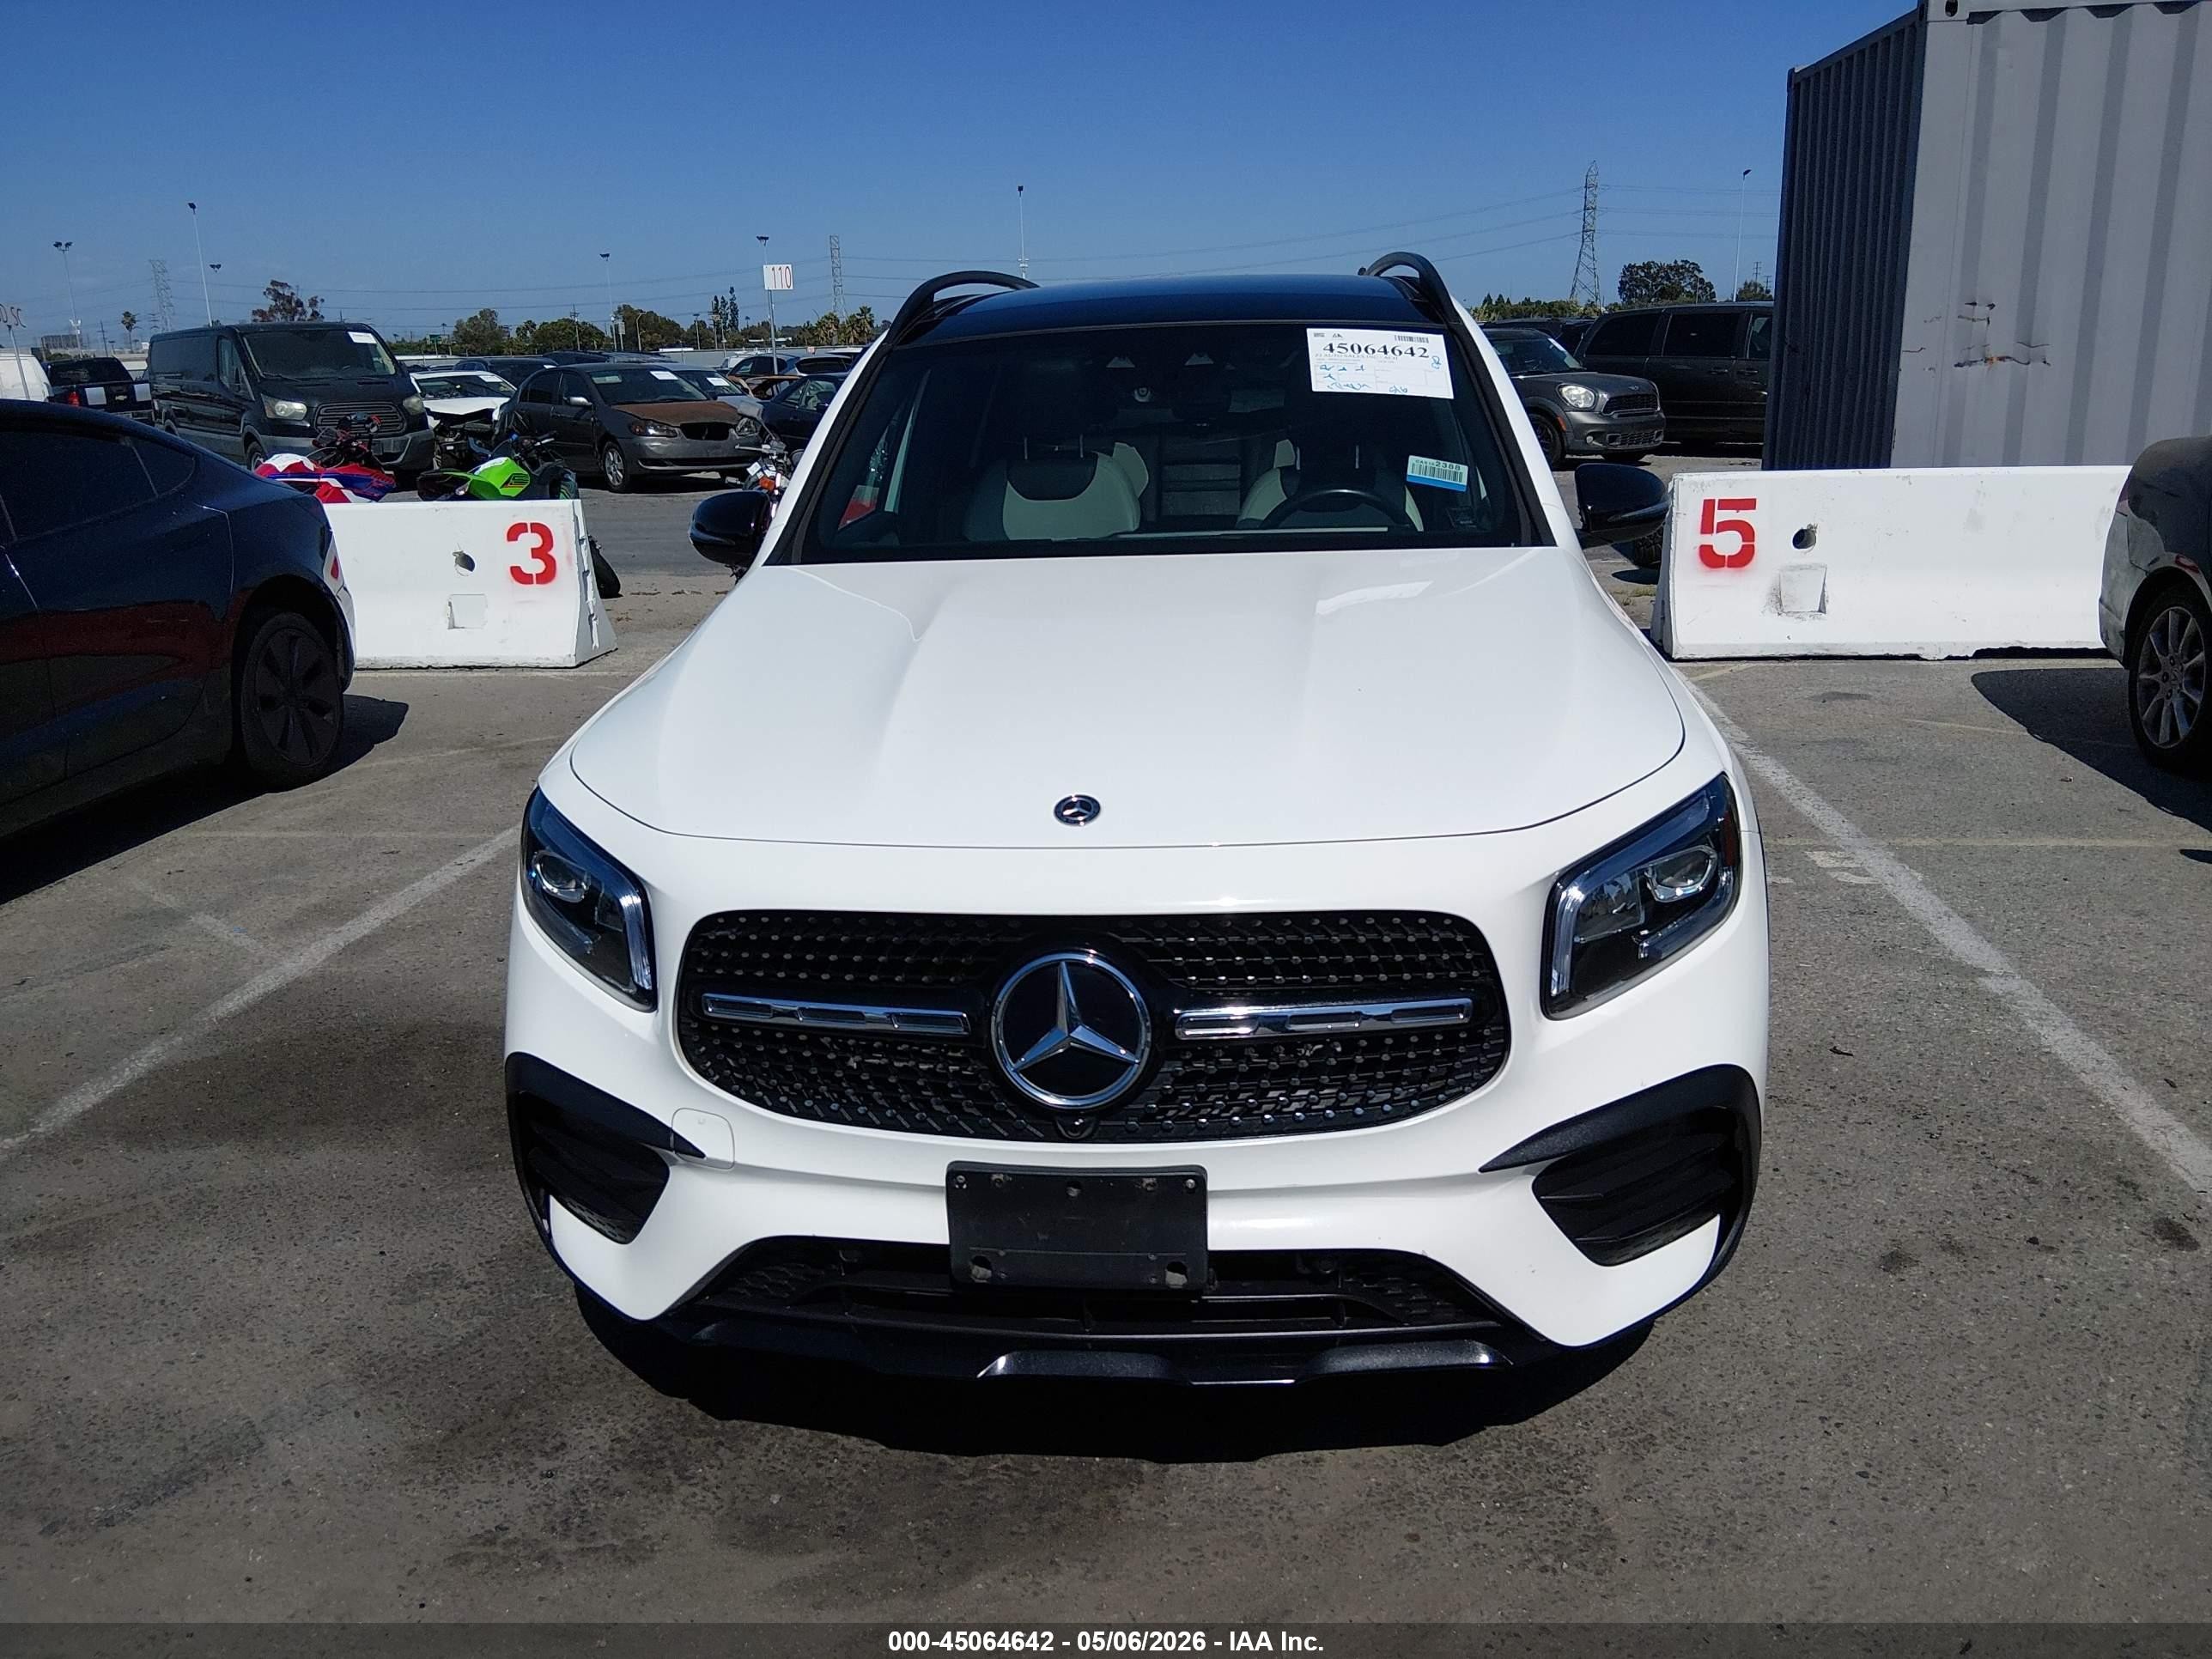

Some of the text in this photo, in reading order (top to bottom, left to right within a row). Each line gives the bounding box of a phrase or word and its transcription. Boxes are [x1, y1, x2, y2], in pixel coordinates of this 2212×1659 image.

[772, 266, 792, 289] 110
[1323, 343, 1430, 358] 45064642
[506, 522, 557, 586] 3
[1698, 498, 1756, 570] 5
